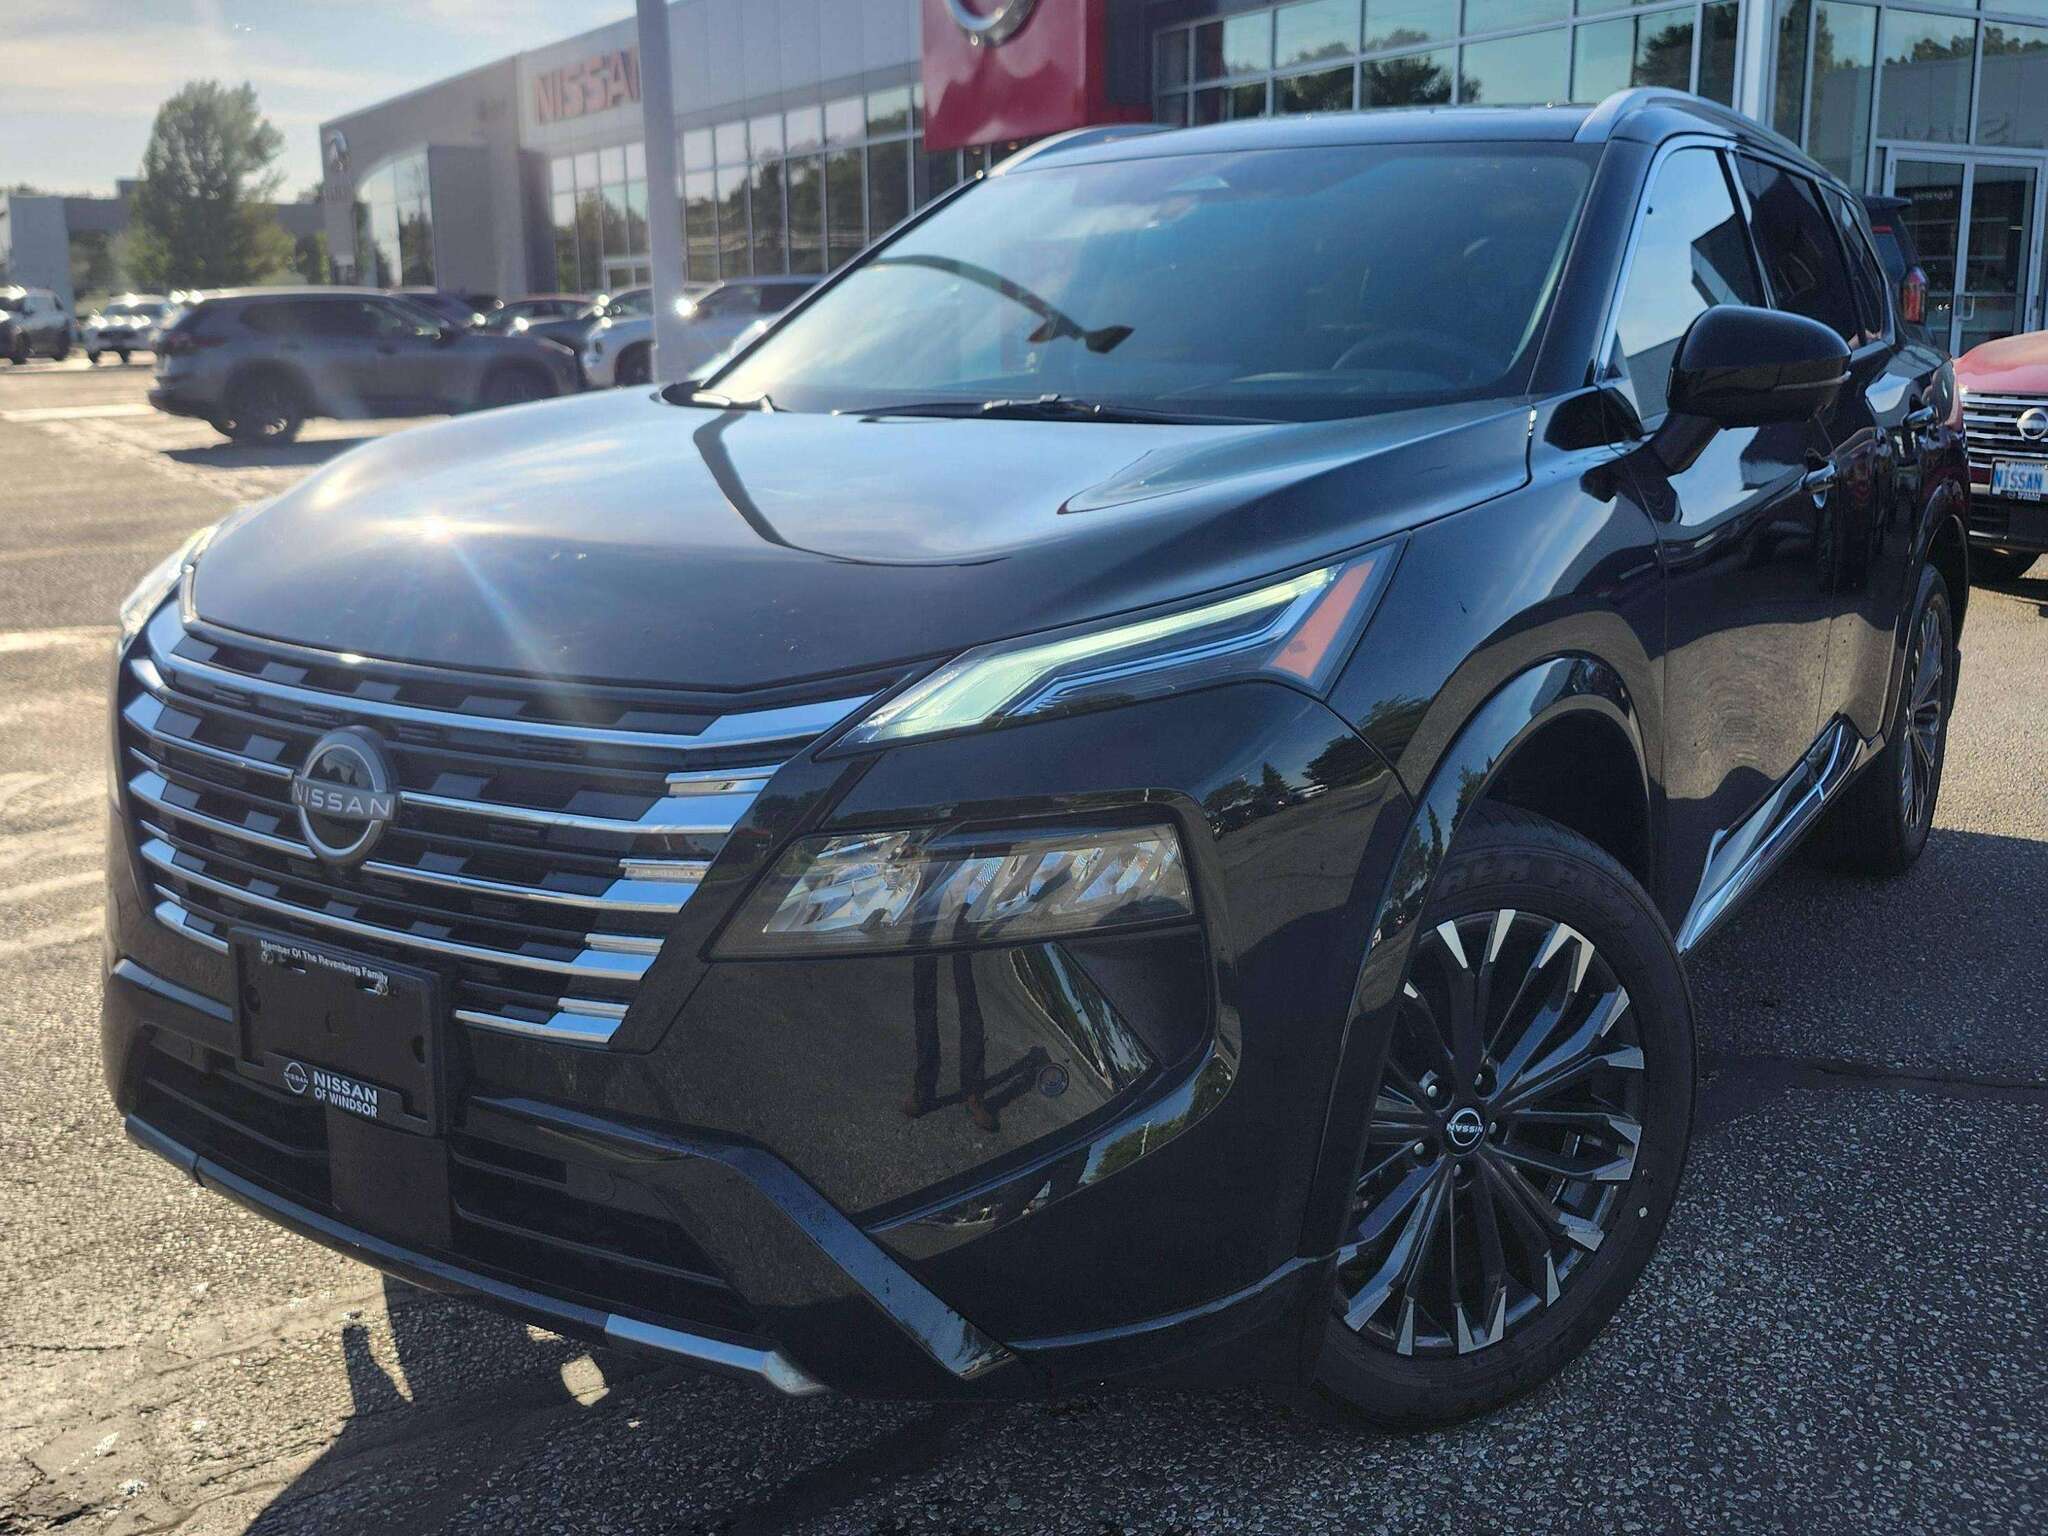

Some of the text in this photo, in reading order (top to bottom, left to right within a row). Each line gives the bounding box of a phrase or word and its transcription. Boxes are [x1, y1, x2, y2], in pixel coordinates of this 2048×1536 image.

[1994, 469, 2043, 489] NISSAN
[293, 781, 391, 817] NISSAN
[260, 940, 291, 956] Member
[302, 950, 317, 963] The
[362, 967, 389, 984] Family
[313, 1070, 378, 1105] NISSAN
[314, 1086, 378, 1119] OF WINDSOR
